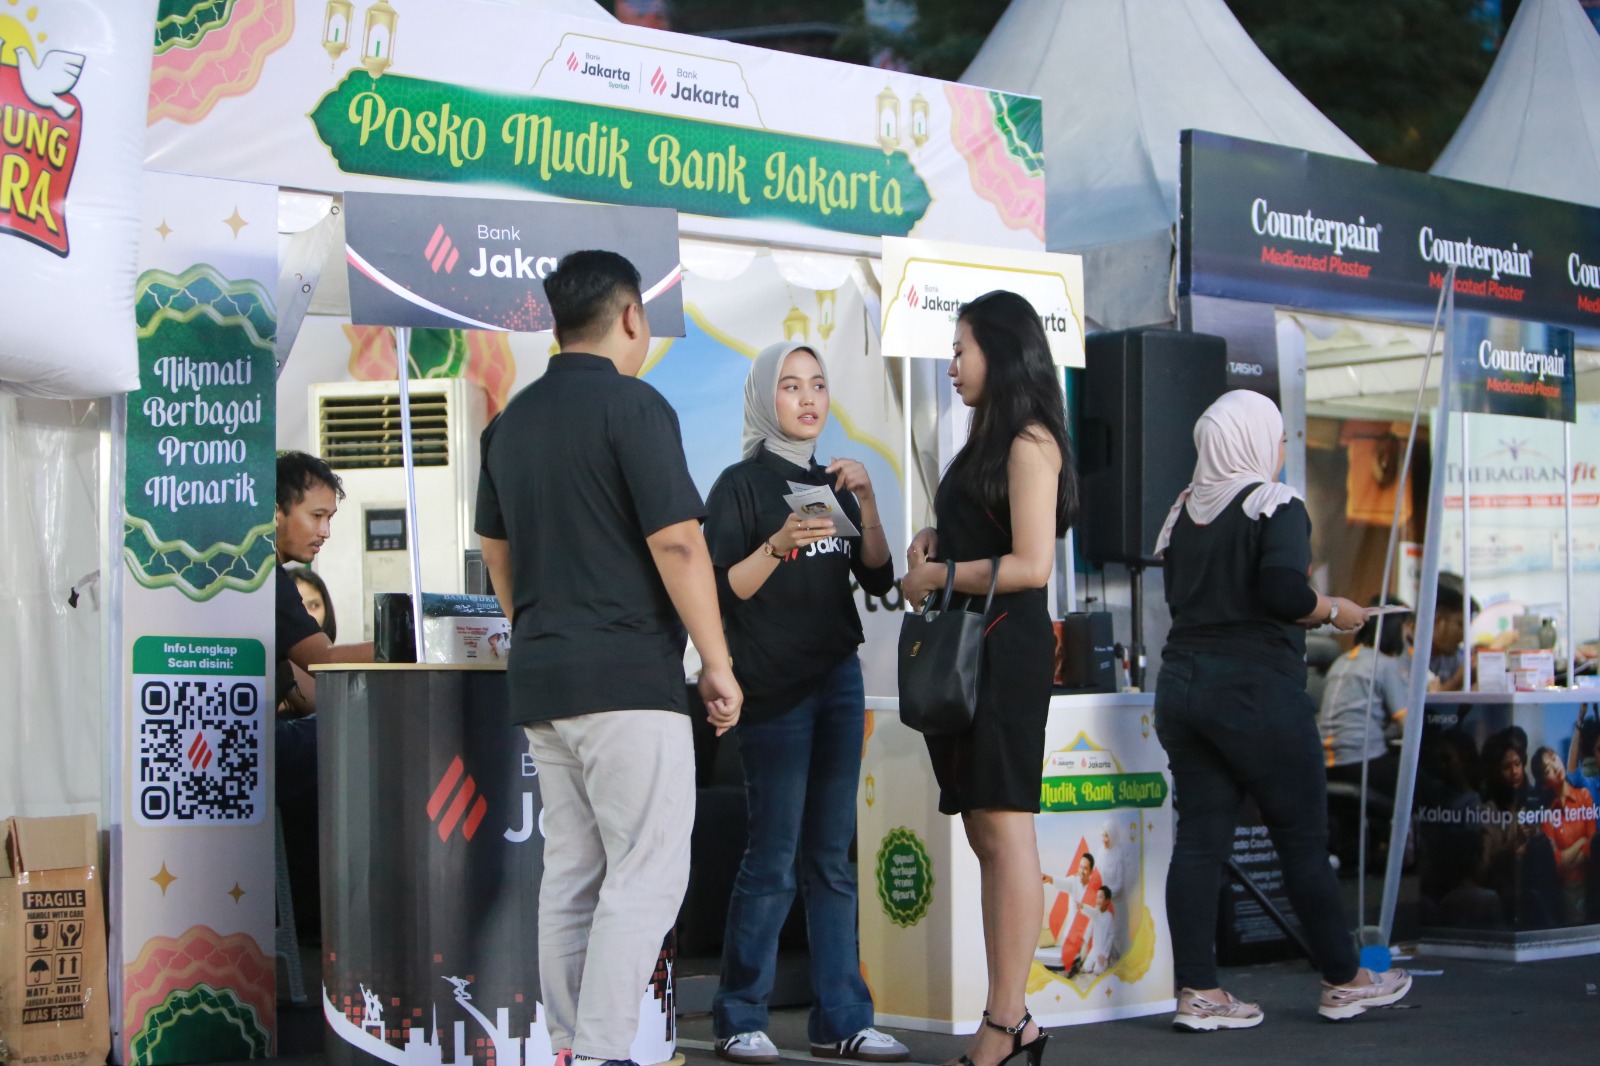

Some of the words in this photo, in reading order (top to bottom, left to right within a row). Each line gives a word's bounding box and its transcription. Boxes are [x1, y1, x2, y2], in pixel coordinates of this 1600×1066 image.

[585, 52, 601, 62] Bank
[580, 62, 631, 82] Jakarta
[676, 68, 698, 80] Bank
[608, 81, 630, 91] Syariah
[670, 82, 740, 109] Jakarta
[0, 104, 70, 171] UNG
[348, 92, 487, 168] Posko
[502, 112, 633, 190] Mudik
[647, 133, 751, 206] Bank
[763, 151, 903, 216] Jakarta
[477, 224, 521, 241] Bank
[1251, 197, 1380, 256] Counterpain
[469, 247, 558, 280] Jaka
[1261, 246, 1327, 273] Medicated
[1329, 255, 1372, 279] Plaster
[1419, 226, 1532, 281] Counterpain
[1568, 252, 1600, 290] Cou
[1488, 279, 1526, 301] Plaster
[921, 295, 968, 313] Jakart
[1479, 339, 1565, 382] Counterpain
[153, 355, 252, 394] Nikmati
[1487, 377, 1535, 396] Medicated
[1535, 381, 1562, 399] Plaster
[143, 393, 262, 435] Berbagai
[158, 436, 247, 467] Promo
[1571, 461, 1598, 485] fit
[144, 472, 258, 513] Menarik
[163, 643, 187, 654] Info
[188, 644, 238, 656] Lengkap
[167, 658, 197, 669] Scan
[198, 659, 234, 669] disini:
[1082, 782, 1116, 804] Bank
[1119, 780, 1162, 803] Jakarta
[1418, 805, 1462, 824] Kalau
[1465, 806, 1514, 830] hidup
[1517, 804, 1562, 828] sering
[1564, 802, 1600, 823] tertek
[26, 891, 84, 908] FRAGILE
[27, 911, 51, 920] HANDLE
[52, 911, 69, 919] WITH
[69, 909, 84, 918] CARE
[26, 987, 49, 998] HATI
[56, 984, 81, 995] HATI
[24, 1007, 49, 1023] AWAS
[51, 1004, 82, 1020] PECAH
